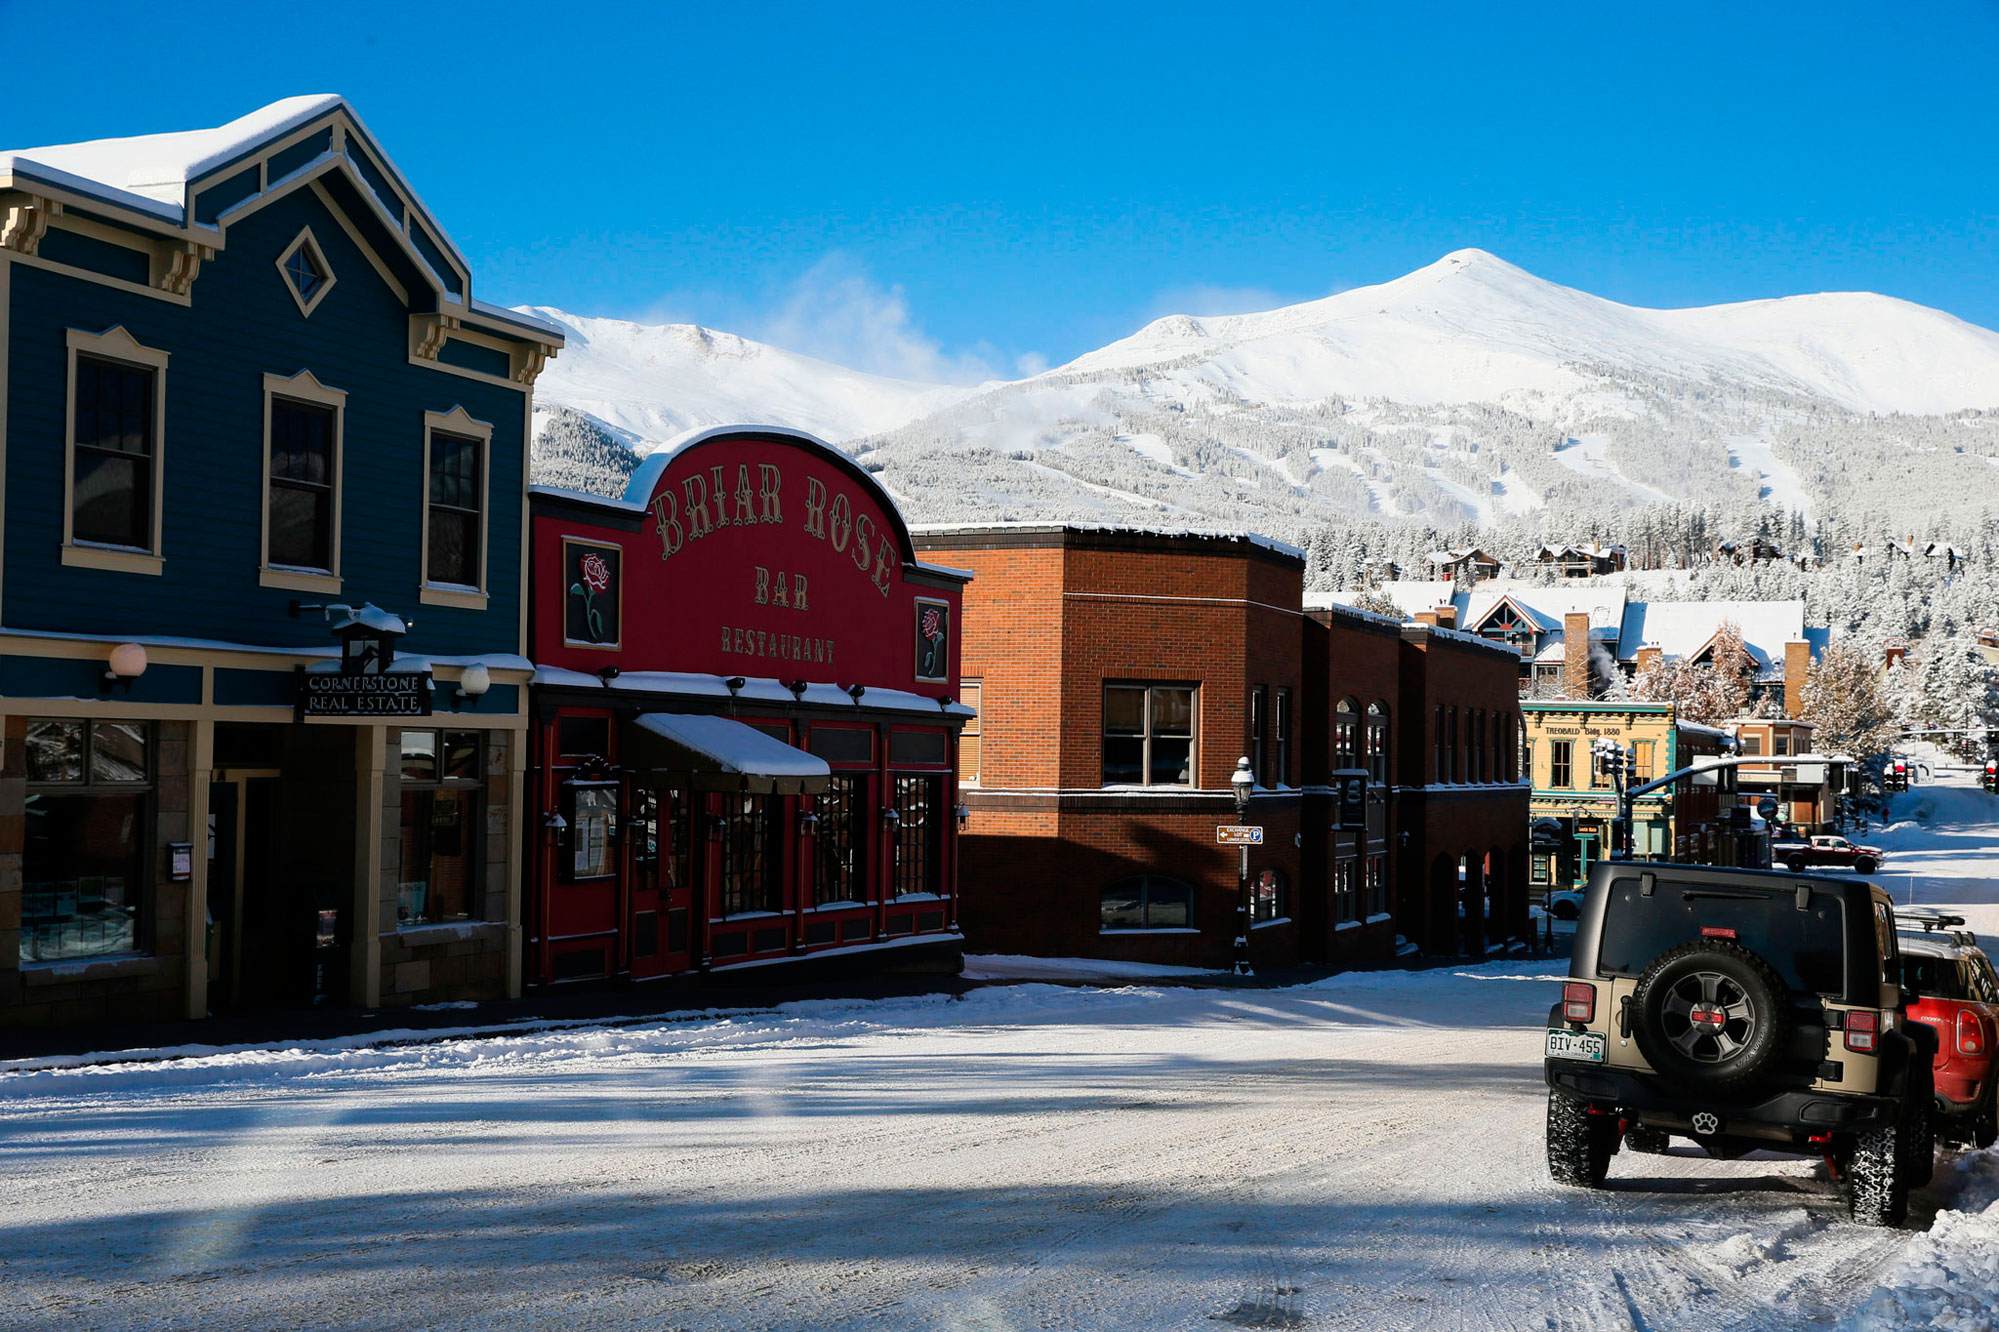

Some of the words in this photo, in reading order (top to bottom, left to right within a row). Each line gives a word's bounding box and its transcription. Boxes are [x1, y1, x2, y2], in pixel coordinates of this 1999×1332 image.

[652, 463, 782, 560] BRIAR
[804, 475, 897, 597] ROSE
[754, 566, 809, 611] BAR
[720, 626, 835, 664] RESTAURANT
[309, 675, 418, 690] CORNERSTONE
[309, 696, 349, 710] REAL
[357, 696, 418, 710] ESTATE
[1604, 728, 1620, 736] 1880
